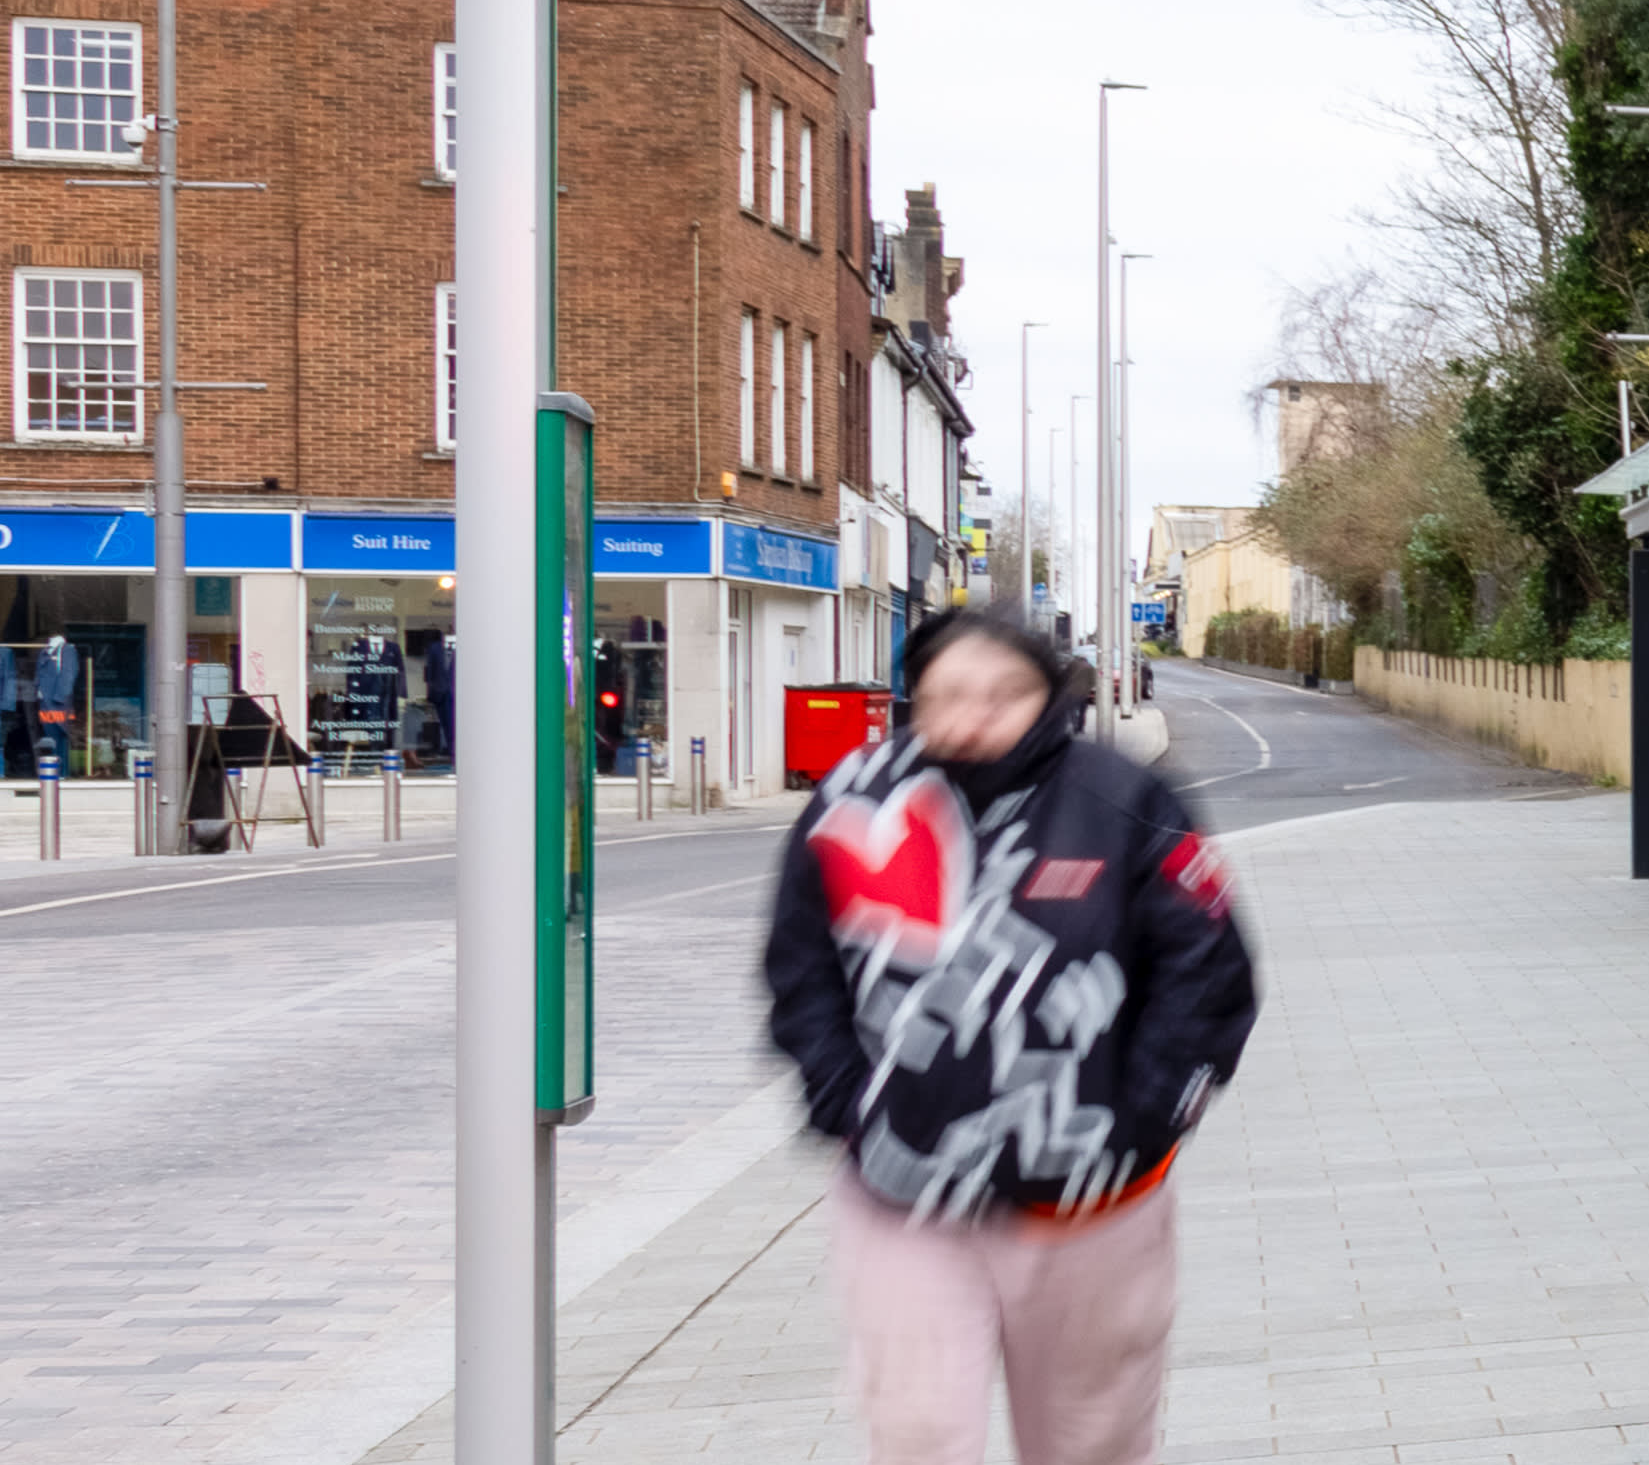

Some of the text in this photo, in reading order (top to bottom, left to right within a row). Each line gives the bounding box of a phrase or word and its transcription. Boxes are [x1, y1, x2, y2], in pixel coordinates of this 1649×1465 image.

[352, 533, 432, 551] Suit Hire
[603, 537, 663, 557] Suiting
[314, 623, 397, 634] Business Suits
[332, 651, 365, 661] Made
[313, 663, 400, 674] Measure Shirts
[332, 693, 380, 703] In-Store
[311, 719, 386, 730] Appointment
